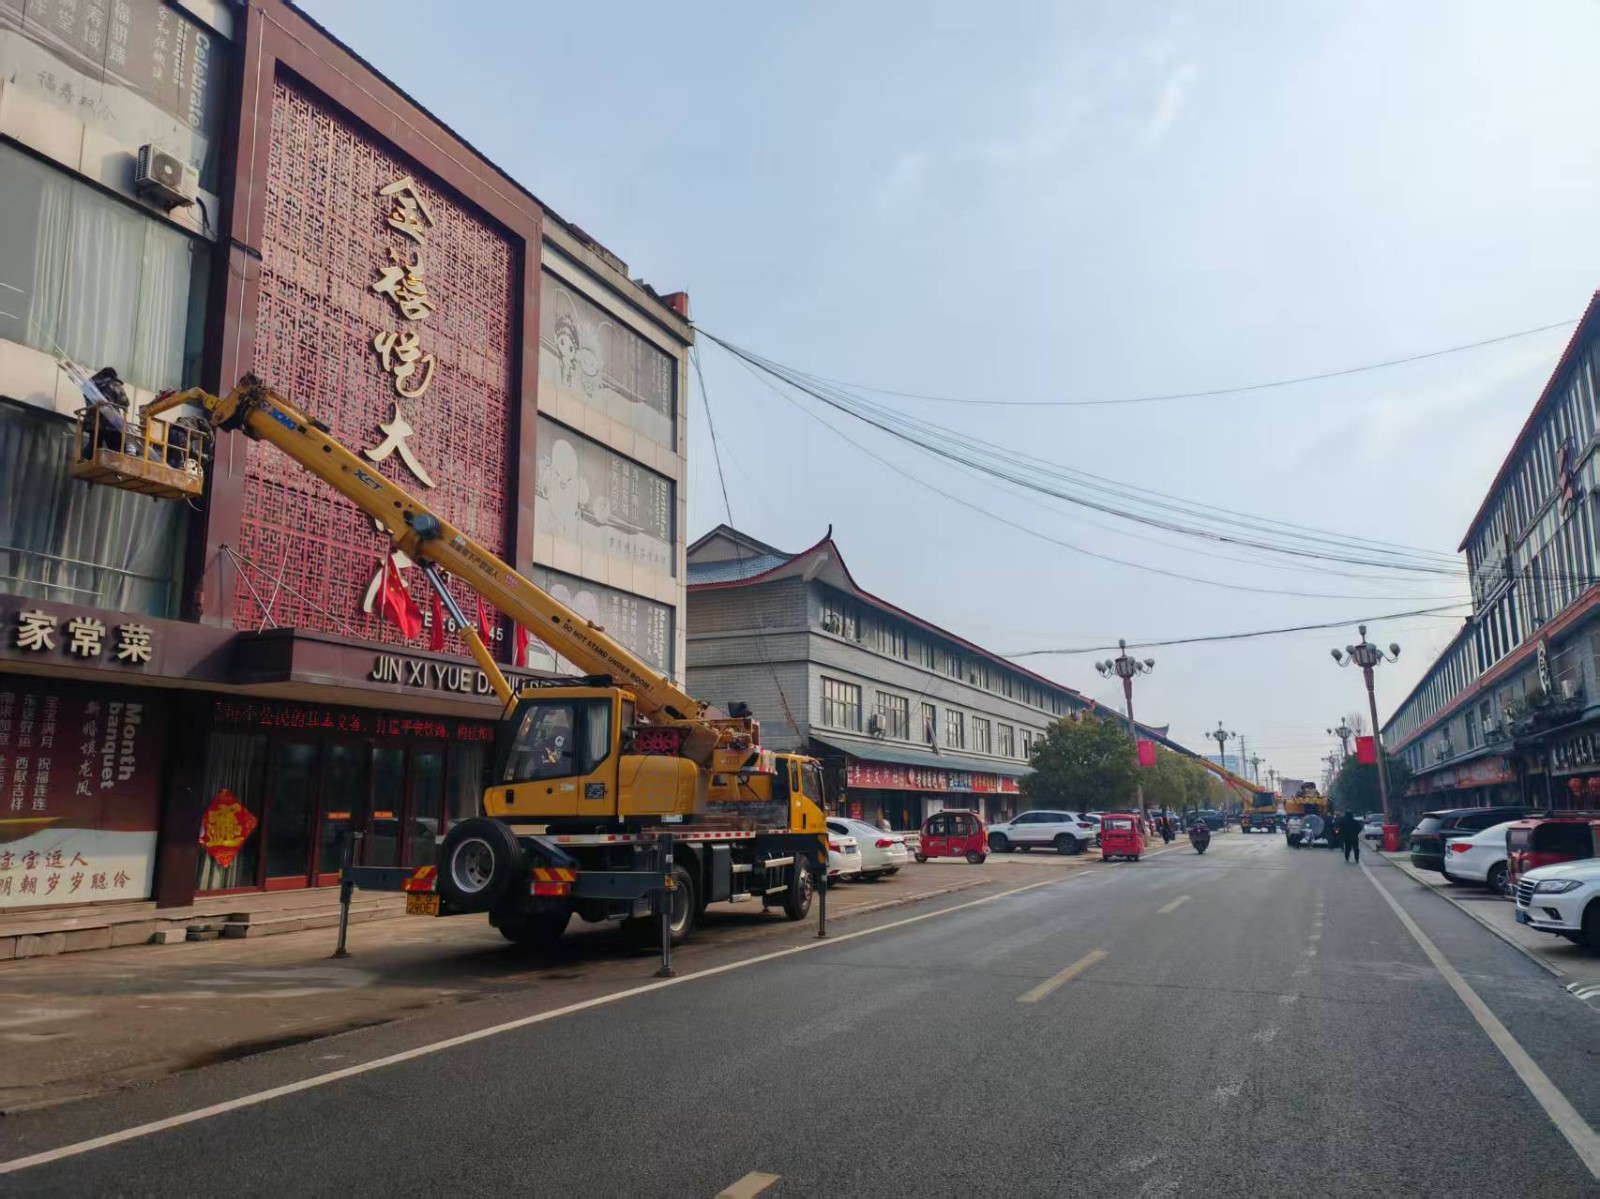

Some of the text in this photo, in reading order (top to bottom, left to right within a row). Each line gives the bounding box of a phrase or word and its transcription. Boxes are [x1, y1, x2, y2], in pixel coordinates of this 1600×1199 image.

[188, 32, 211, 128] Celebrate
[363, 176, 436, 613] 金禧悦大
[16, 609, 153, 662] 家常菜
[373, 655, 402, 682] JIN
[409, 660, 428, 686] XI
[435, 664, 472, 692] YUE
[562, 623, 573, 632] DO
[572, 630, 587, 643] NOT
[586, 640, 608, 658] STAND
[608, 654, 631, 674] UNDER
[101, 701, 124, 789] banquet
[118, 703, 143, 780] Month
